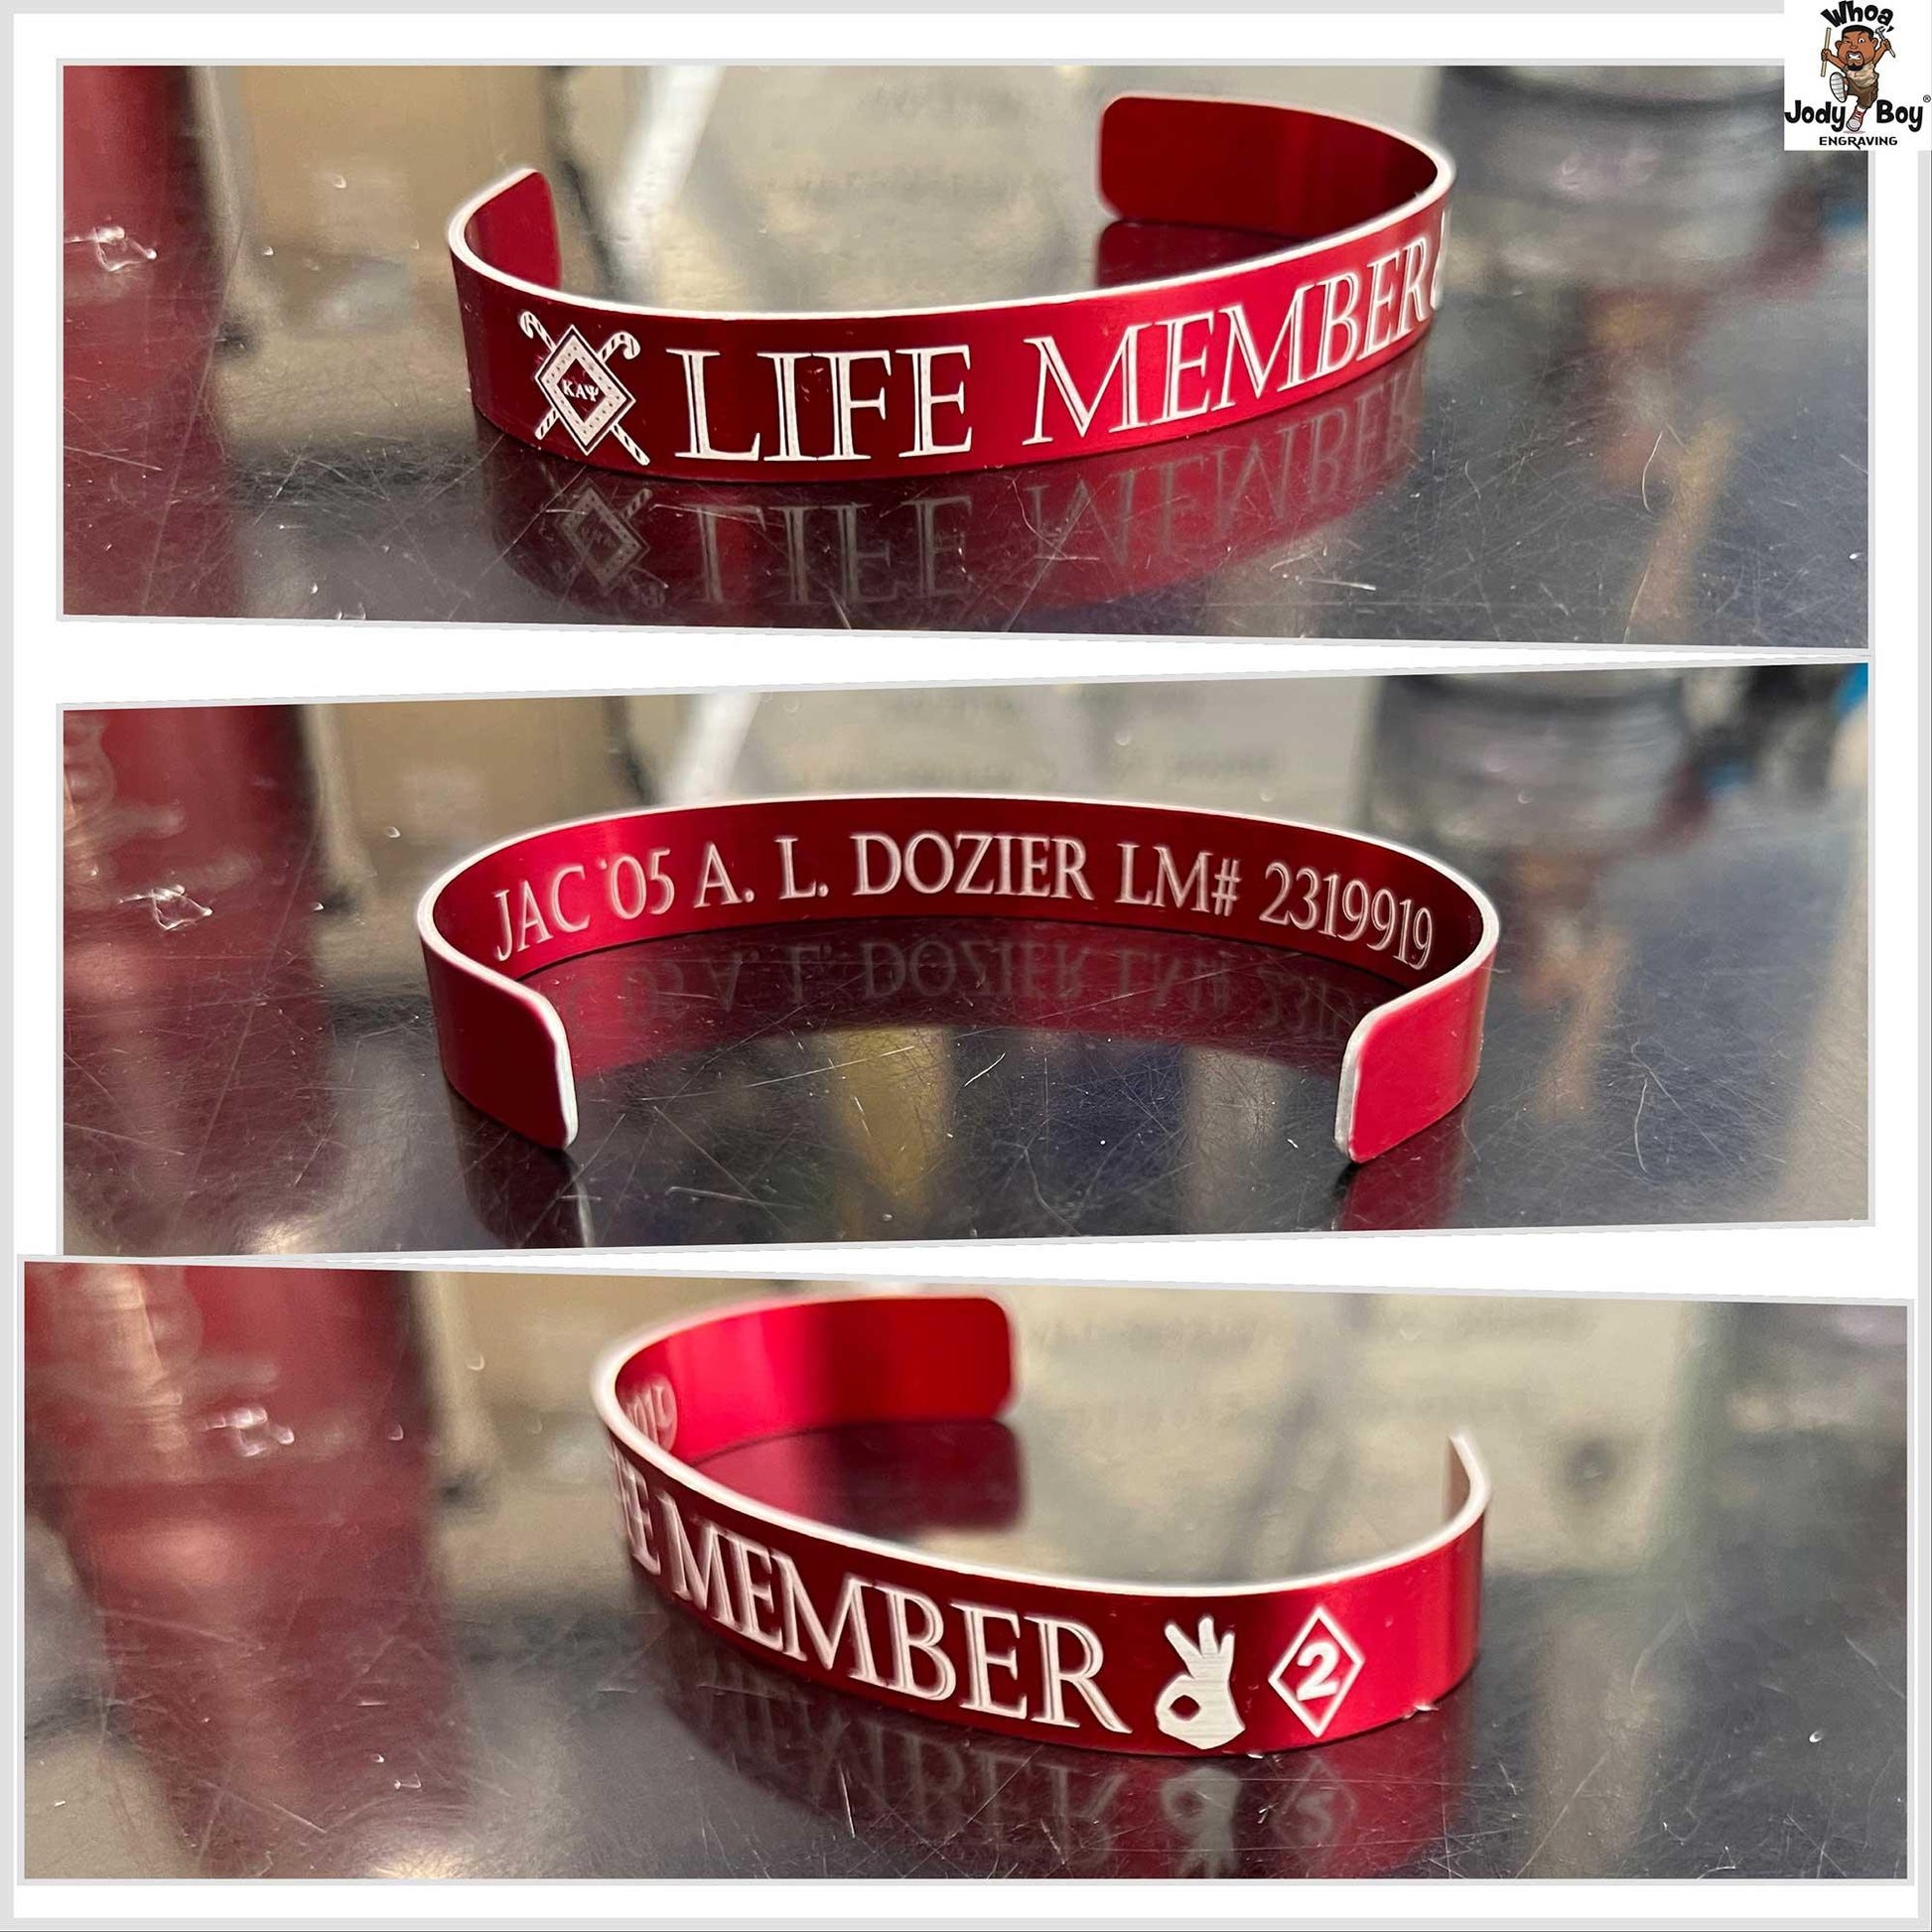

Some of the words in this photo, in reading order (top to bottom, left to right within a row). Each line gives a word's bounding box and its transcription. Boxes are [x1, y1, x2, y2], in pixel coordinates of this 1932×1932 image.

[666, 344, 973, 462] LIFE
[1023, 236, 1431, 446] MEMBER
[493, 865, 591, 962] JAC
[694, 842, 755, 908] A.
[774, 836, 828, 899] L.
[850, 831, 1095, 901] DOZIER
[1114, 842, 1242, 916] LM#
[1259, 861, 1434, 970] 2319919
[656, 1491, 1133, 1733] MEMBER
[1297, 1640, 1341, 1702] 2
